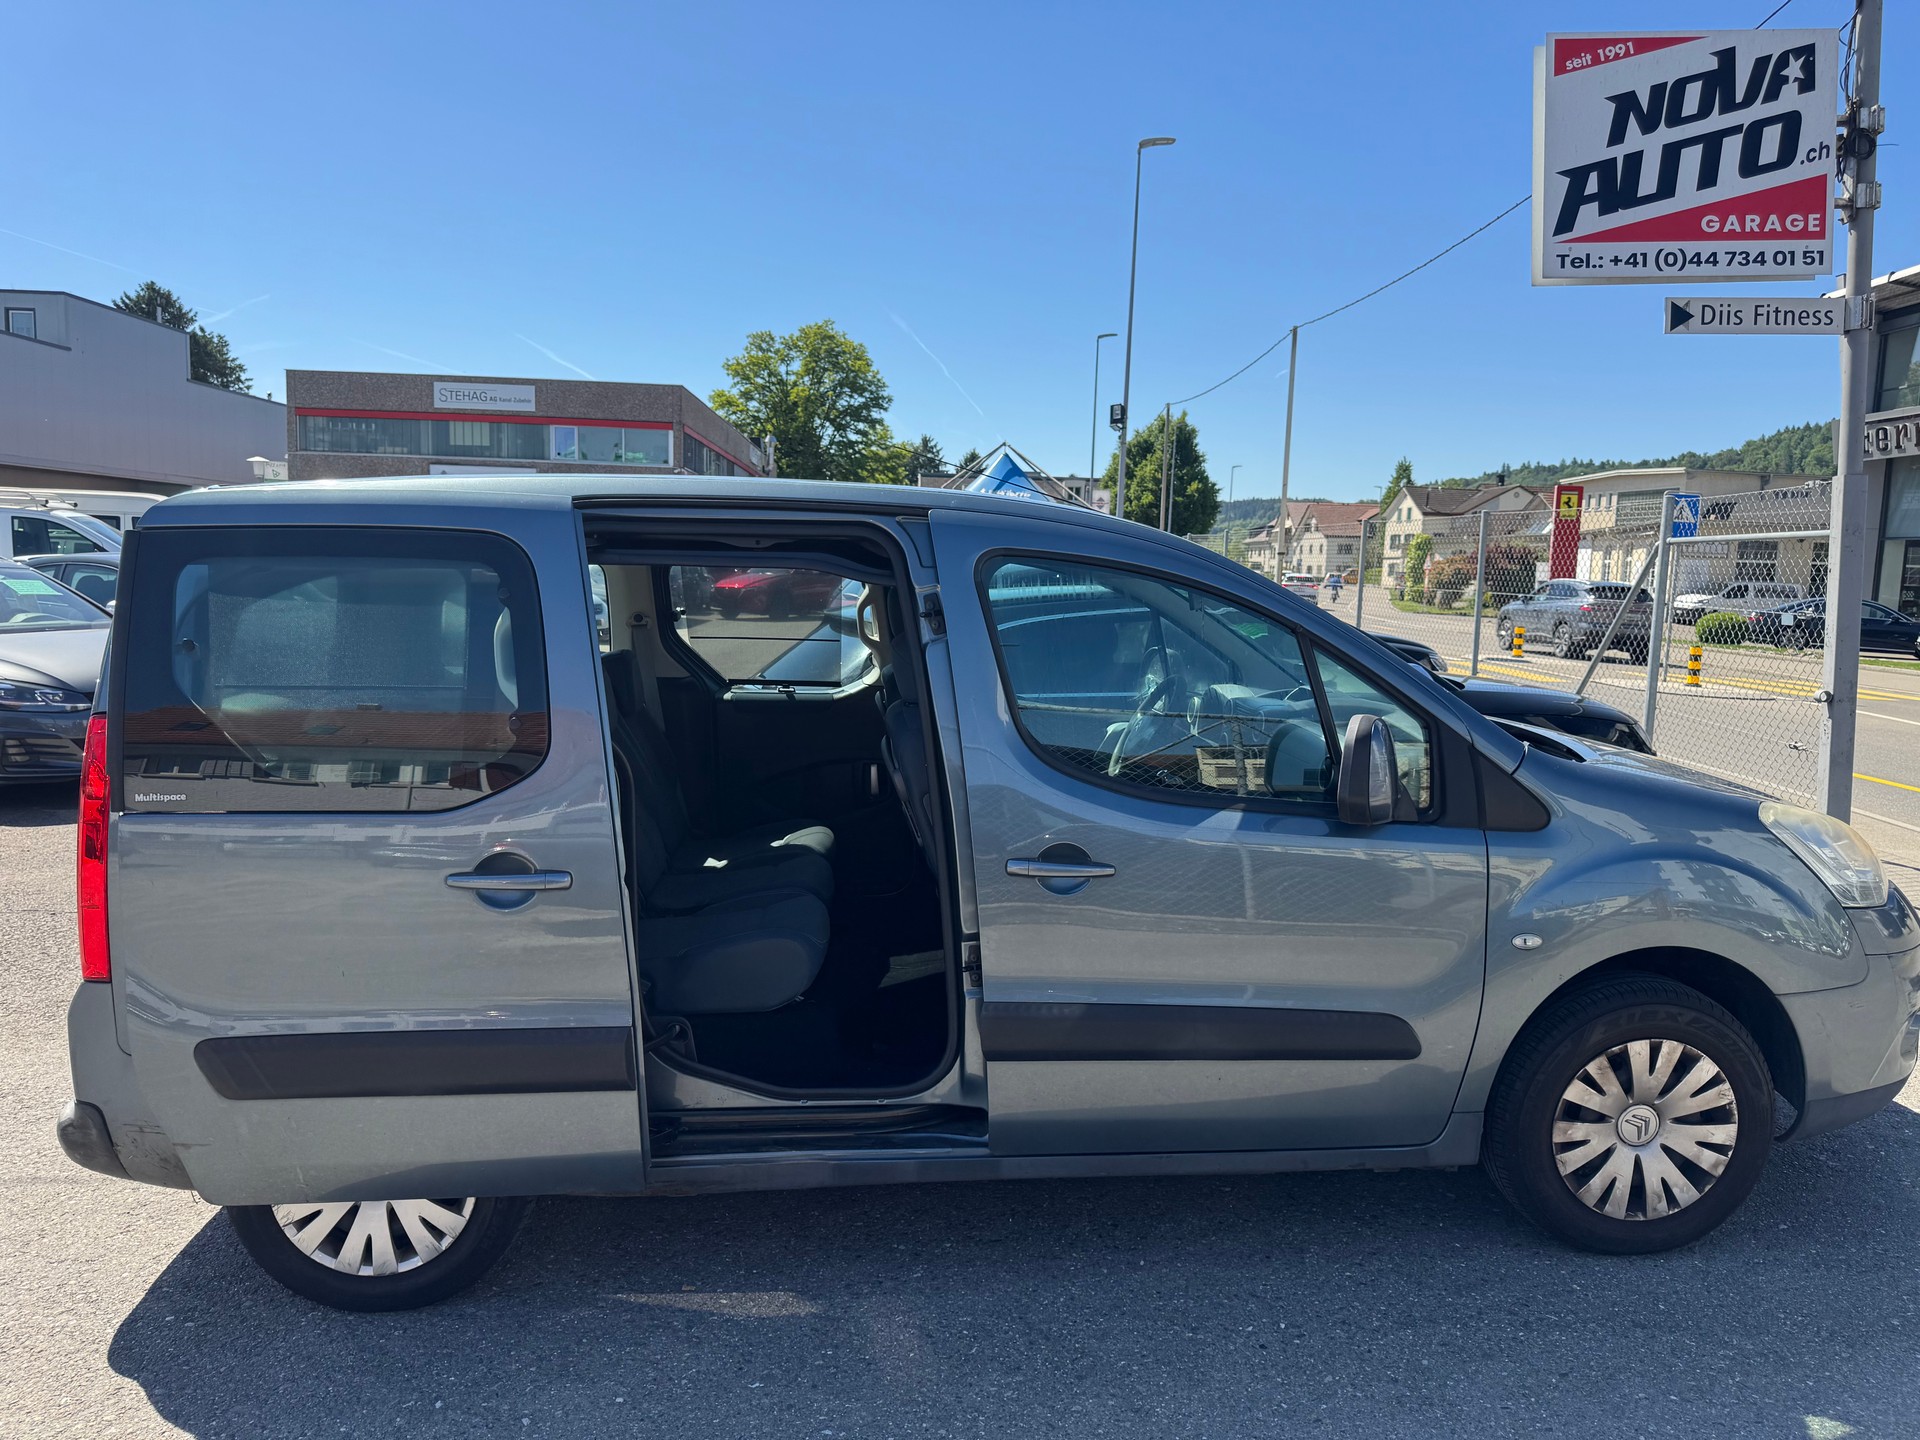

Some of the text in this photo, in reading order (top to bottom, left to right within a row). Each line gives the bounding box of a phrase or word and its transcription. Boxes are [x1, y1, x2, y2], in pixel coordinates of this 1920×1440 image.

[1565, 41, 1635, 70] seit 1991
[1604, 42, 1816, 148] NOVA
[1701, 213, 1821, 233] GARAGE
[1556, 248, 1825, 272] Tel.: +41 (0)44 734 01 51
[1701, 304, 1834, 326] Diis Fitness
[438, 387, 488, 403] STEHAG
[134, 793, 187, 802] Multispace
